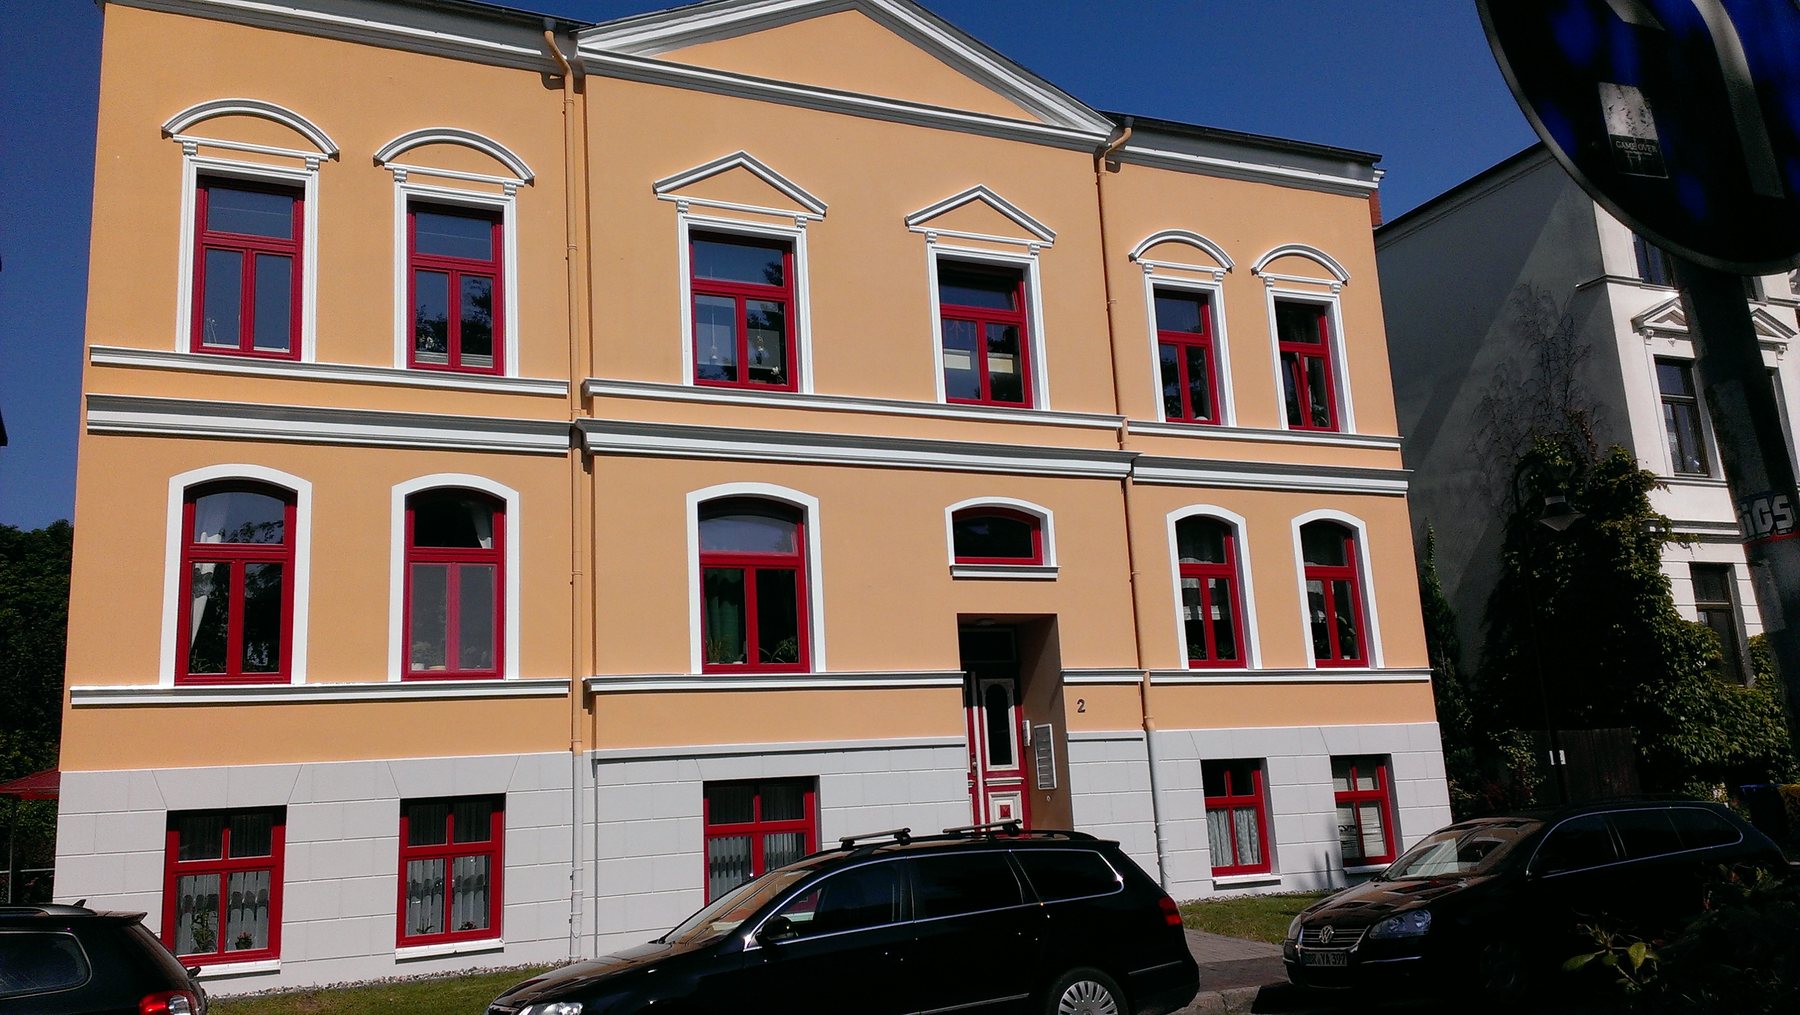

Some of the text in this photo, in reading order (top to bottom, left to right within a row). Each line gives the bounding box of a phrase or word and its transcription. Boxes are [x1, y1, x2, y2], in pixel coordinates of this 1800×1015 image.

[1615, 140, 1638, 151] GAME
[1638, 143, 1658, 153] OVER
[1077, 698, 1086, 713] 2
